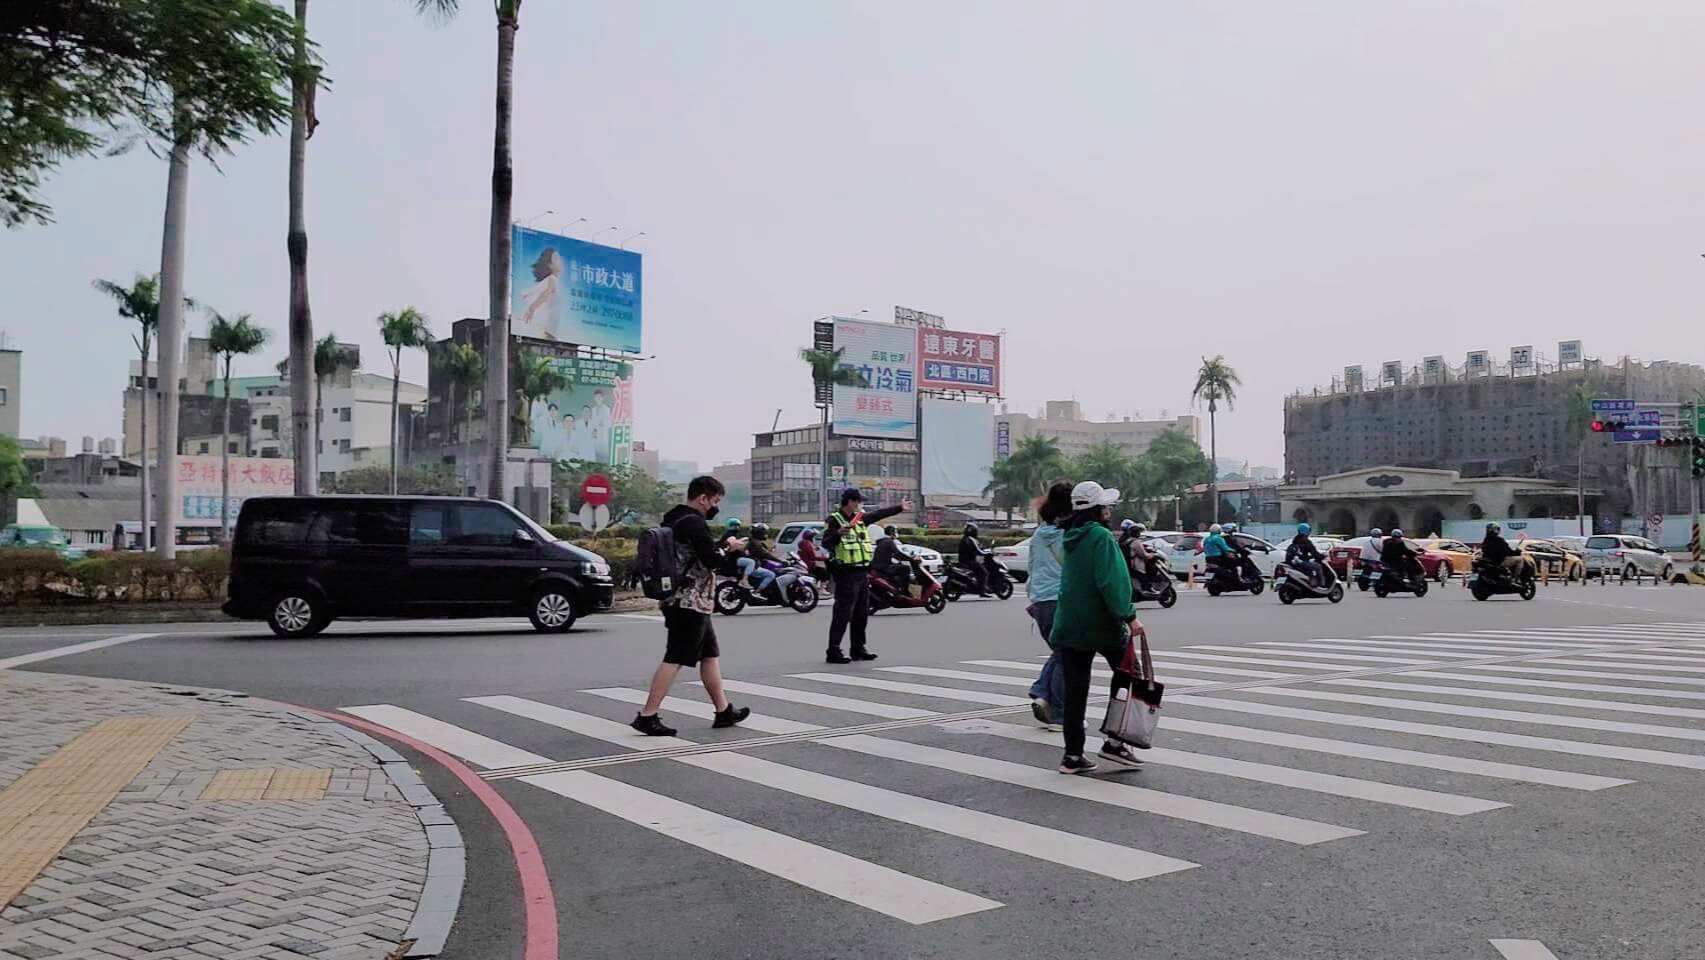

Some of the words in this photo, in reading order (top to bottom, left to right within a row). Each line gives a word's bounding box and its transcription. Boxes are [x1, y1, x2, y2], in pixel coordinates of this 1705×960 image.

[582, 263, 635, 293] 市政大道
[923, 333, 995, 361] 遠東牙醫
[837, 363, 913, 393] 立冷氣
